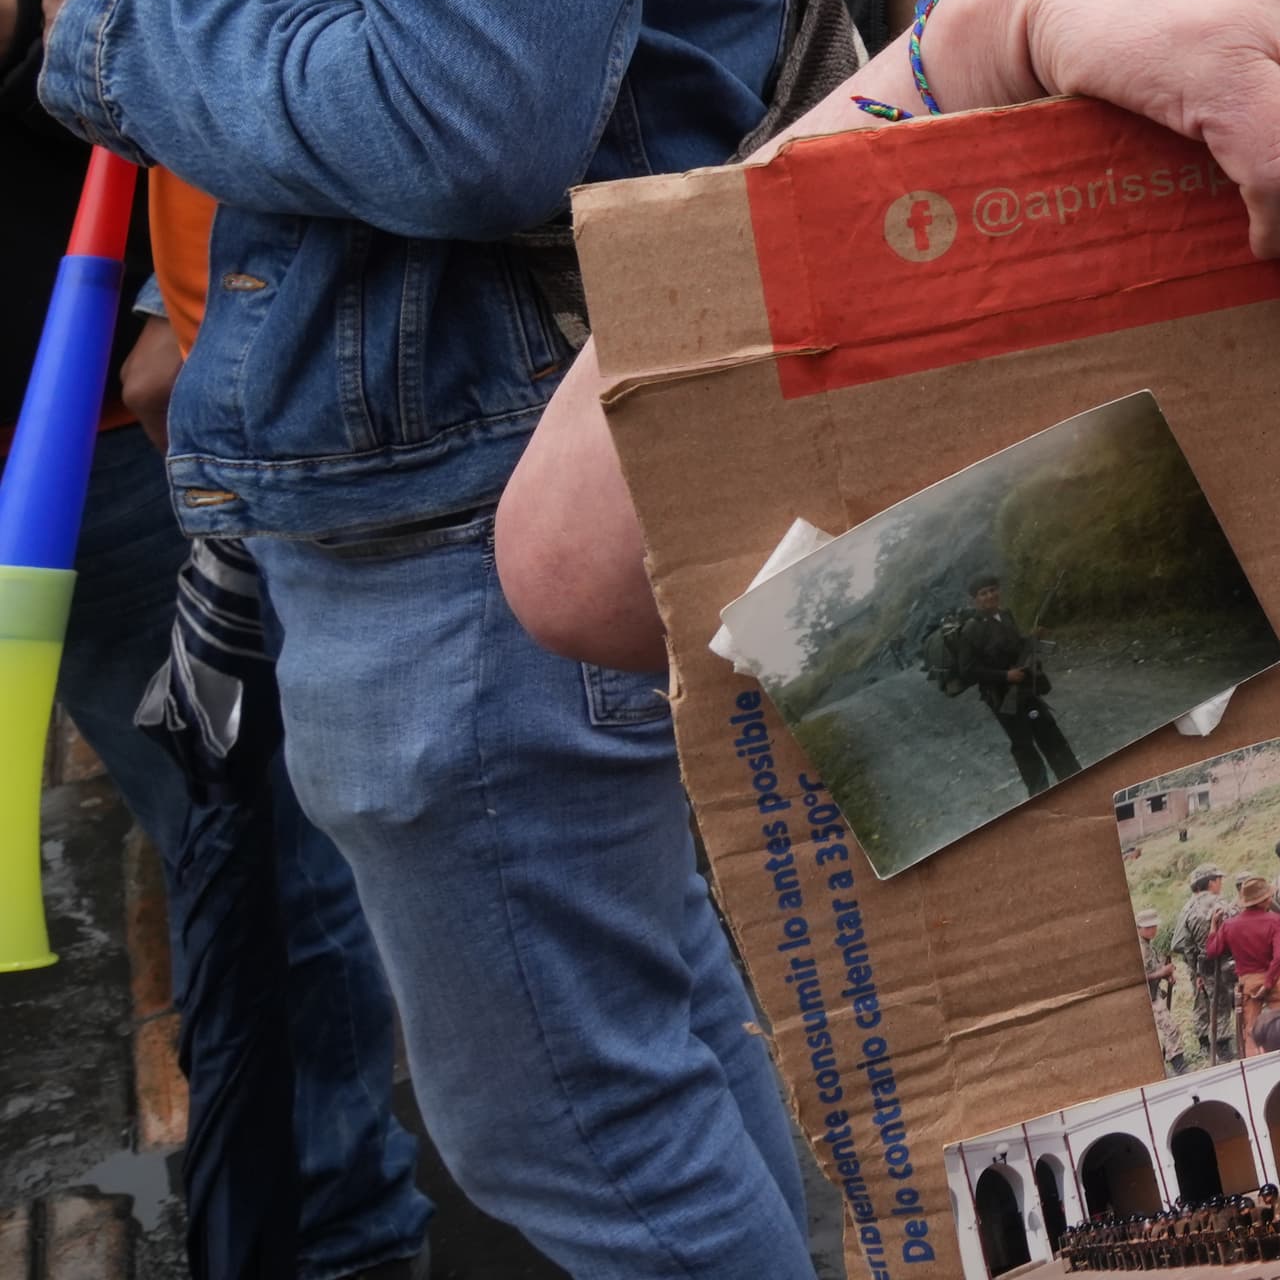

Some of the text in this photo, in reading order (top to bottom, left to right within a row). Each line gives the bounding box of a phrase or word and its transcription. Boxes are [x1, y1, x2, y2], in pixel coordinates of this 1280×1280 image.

[972, 161, 1229, 237] @aprissap
[730, 690, 791, 814] posible
[763, 820, 804, 910] antes
[828, 870, 854, 889] a
[777, 917, 812, 952] lo
[832, 899, 882, 1029] calentar
[785, 958, 844, 1104] consumir
[857, 1036, 913, 1180] contrario
[891, 1187, 924, 1215] lo
[902, 1219, 935, 1264] De
